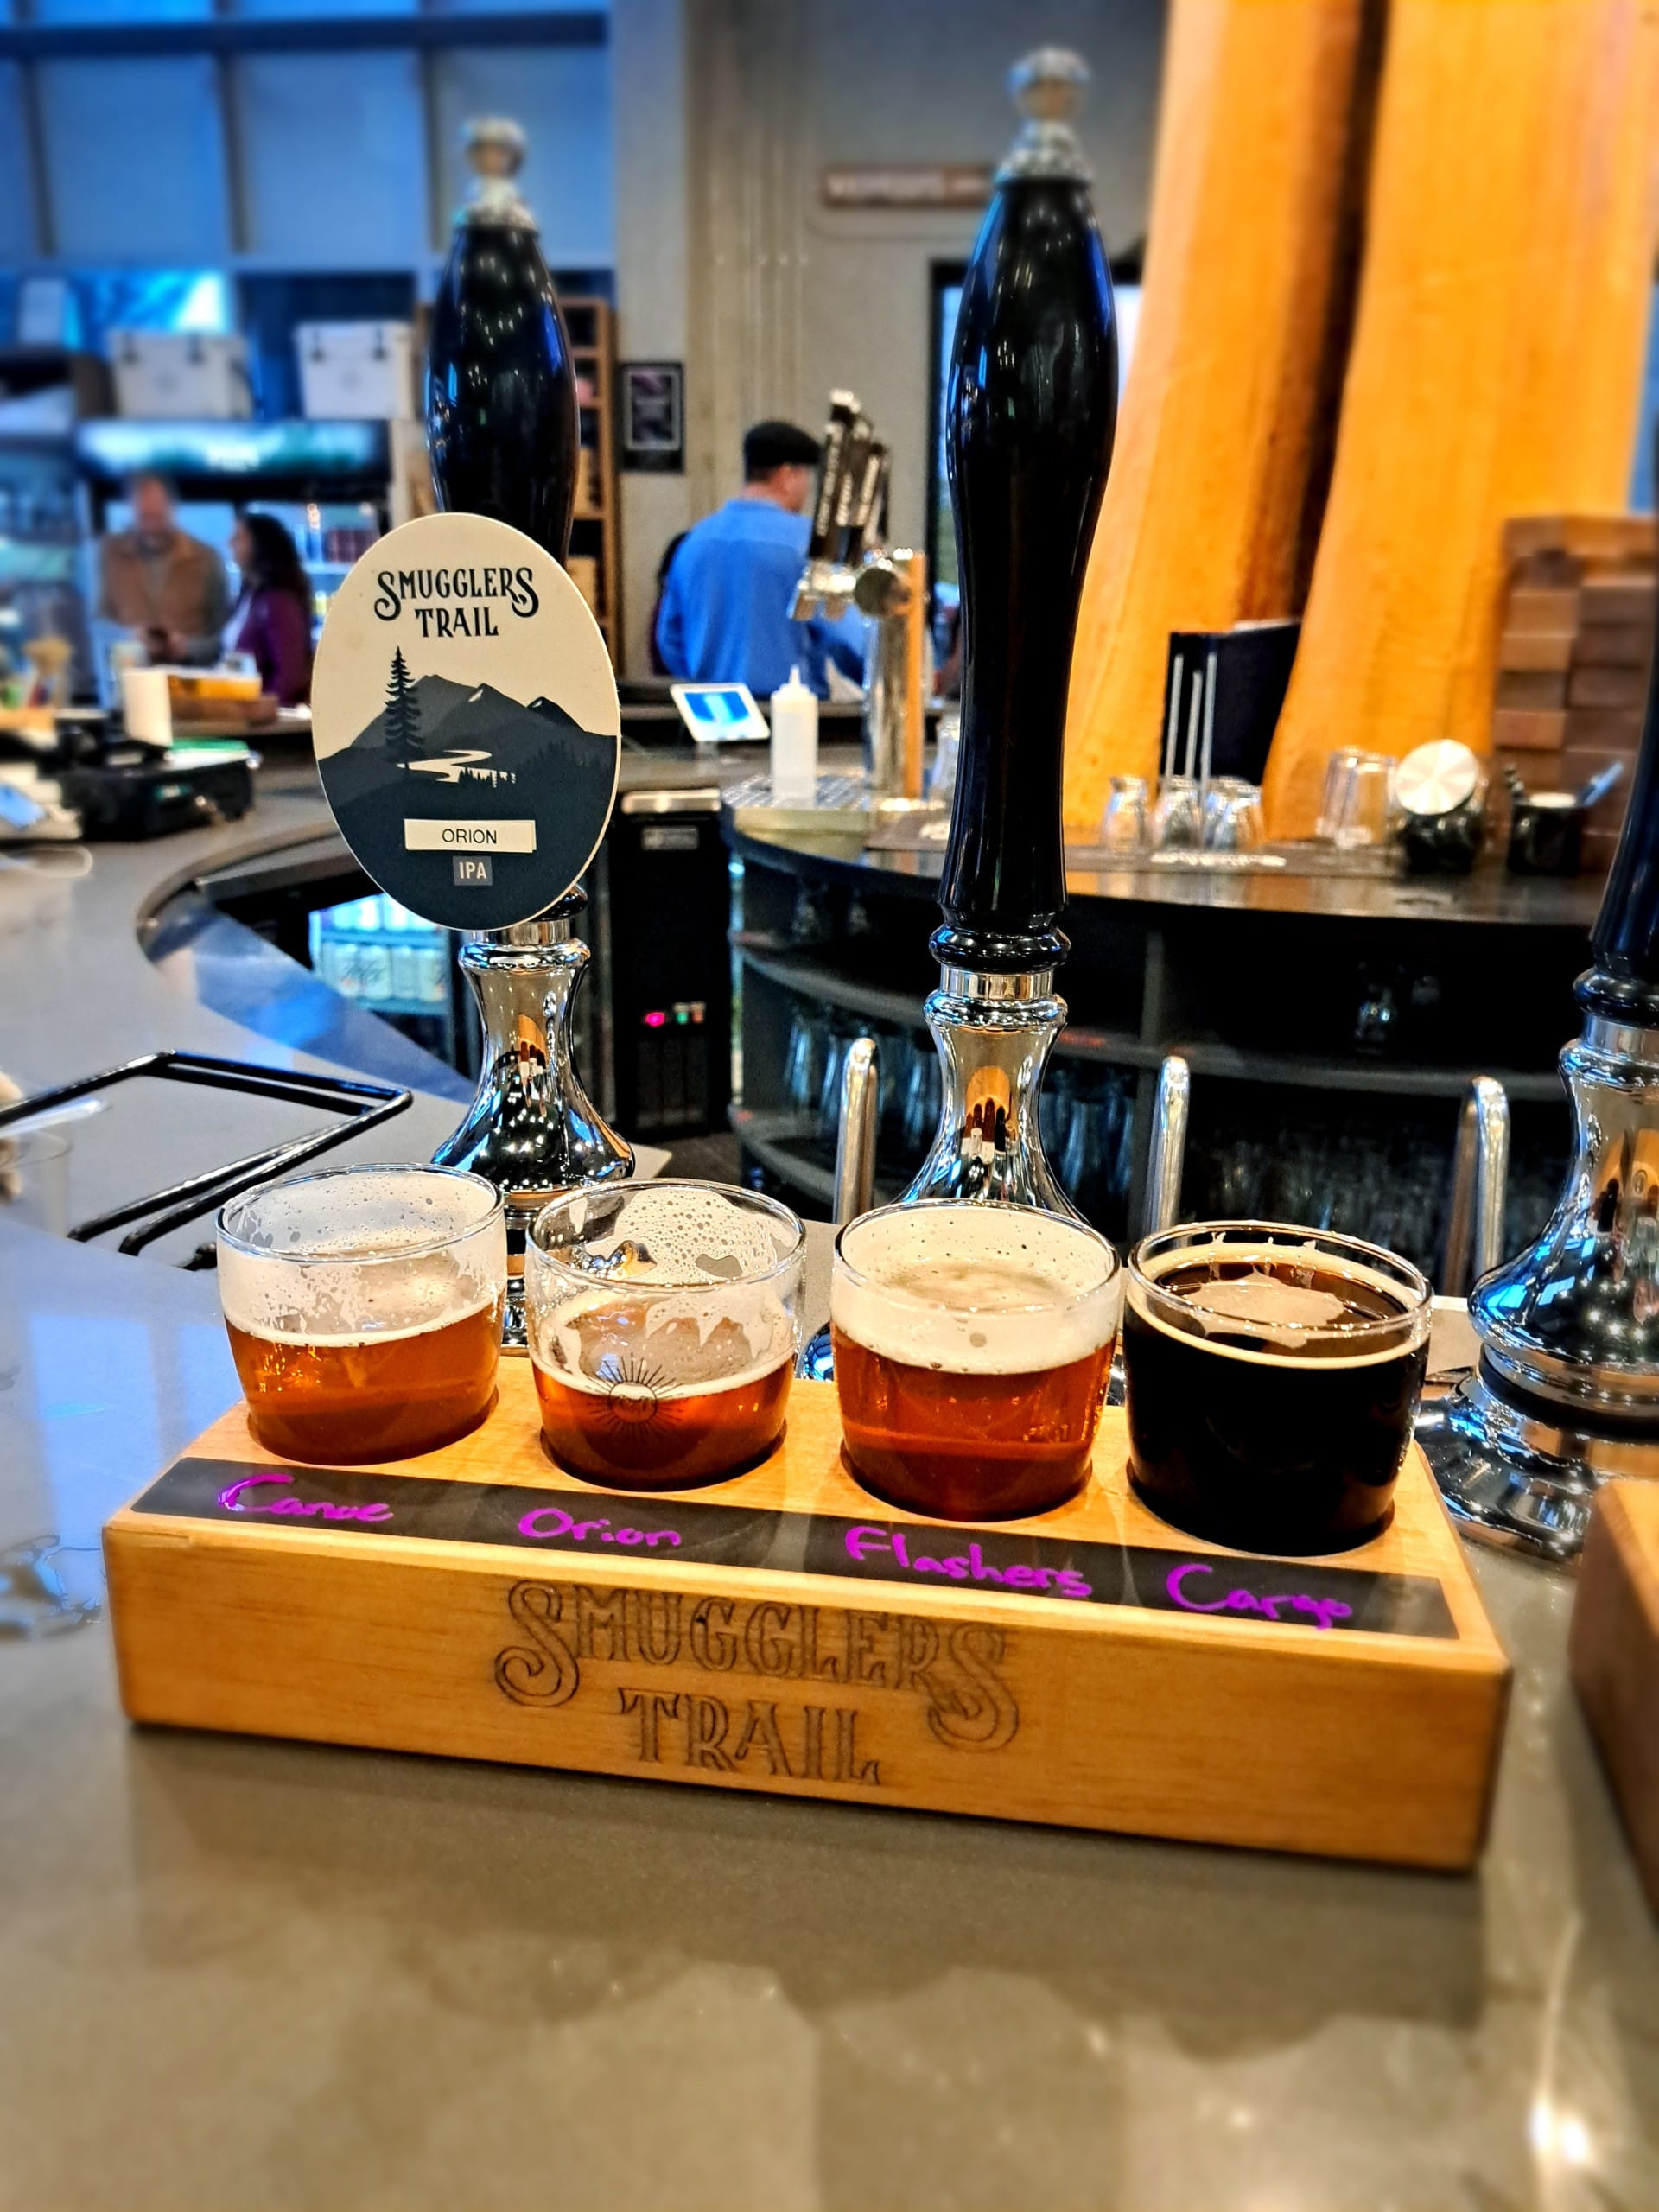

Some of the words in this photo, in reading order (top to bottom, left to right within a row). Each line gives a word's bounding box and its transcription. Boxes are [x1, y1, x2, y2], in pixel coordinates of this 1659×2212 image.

[374, 567, 539, 621] SMUGGLERS
[415, 607, 499, 638] TRAIL
[442, 829, 497, 844] ORION
[459, 861, 487, 880] IPA
[518, 1508, 681, 1546] Orion
[845, 1526, 1092, 1598] Flashers
[494, 1580, 1019, 1752] SMUGGLERS
[619, 1687, 880, 1786] TRAIL
